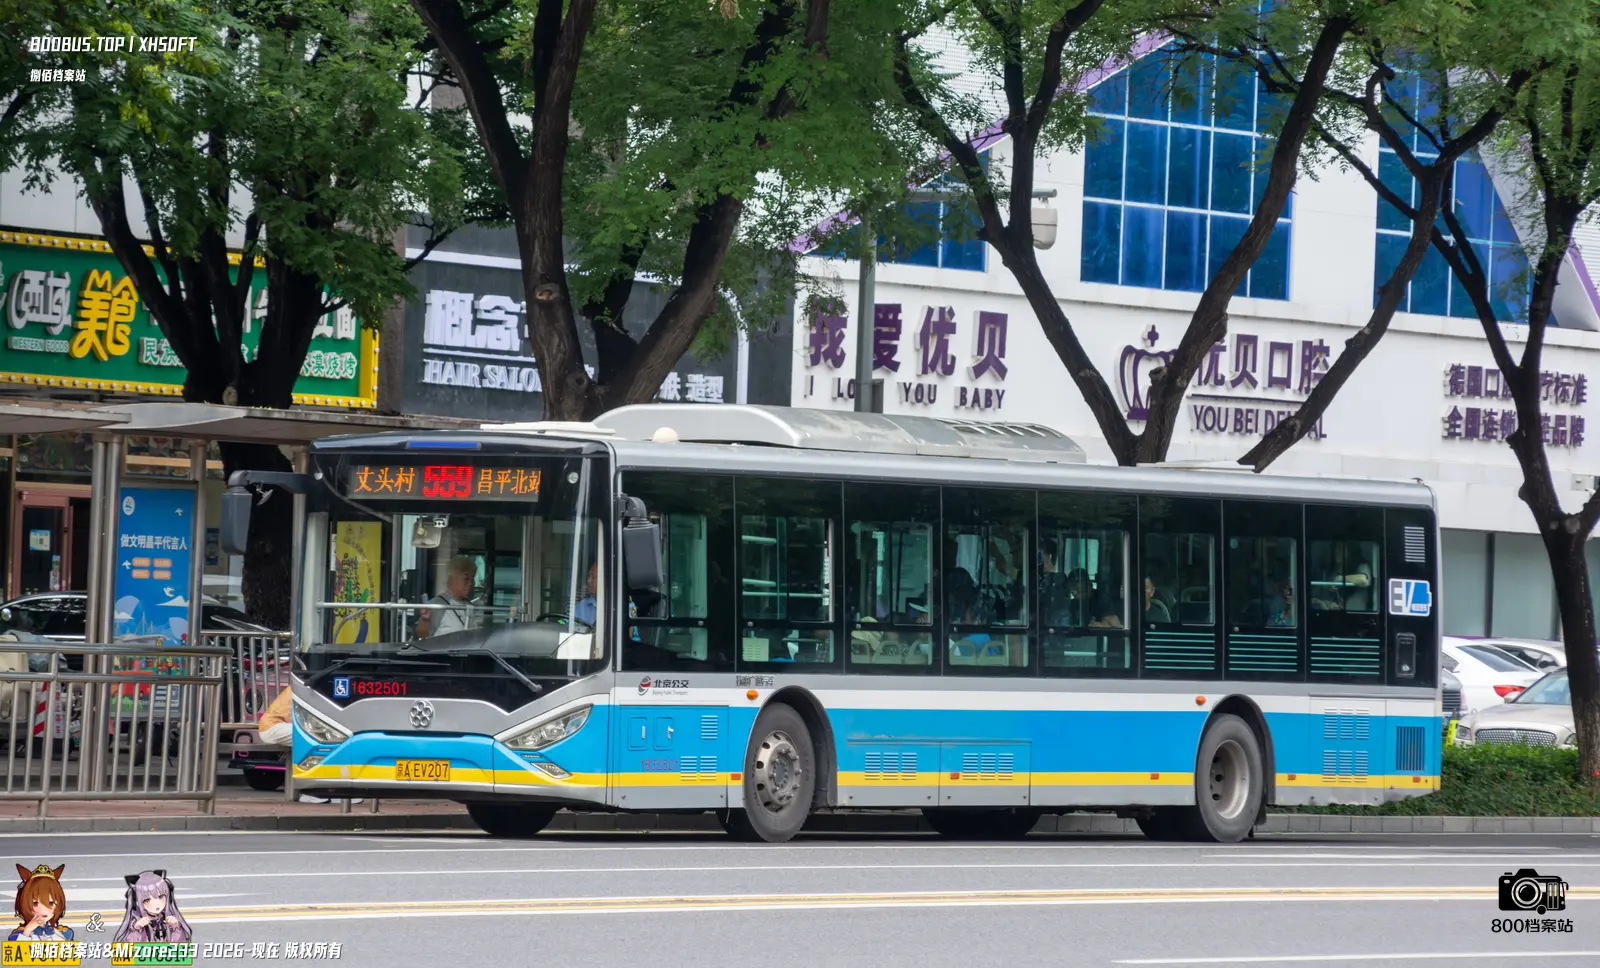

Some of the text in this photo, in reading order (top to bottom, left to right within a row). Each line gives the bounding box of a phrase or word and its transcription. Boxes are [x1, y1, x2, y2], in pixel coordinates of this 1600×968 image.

[424, 289, 529, 351] 概念
[809, 297, 1008, 381] 我爱优贝
[422, 359, 542, 392] HAIR SALO
[903, 382, 938, 405] YOU
[959, 386, 1006, 410] BABY
[1193, 404, 1229, 433] YOU
[1233, 407, 1259, 434] BEI
[354, 466, 415, 493] 丈头村
[423, 465, 473, 498] 559
[120, 533, 188, 551] 做文明昌平代言人
[352, 681, 407, 696] 1632501
[654, 679, 690, 689] 北京公交
[641, 759, 679, 771] 1632501
